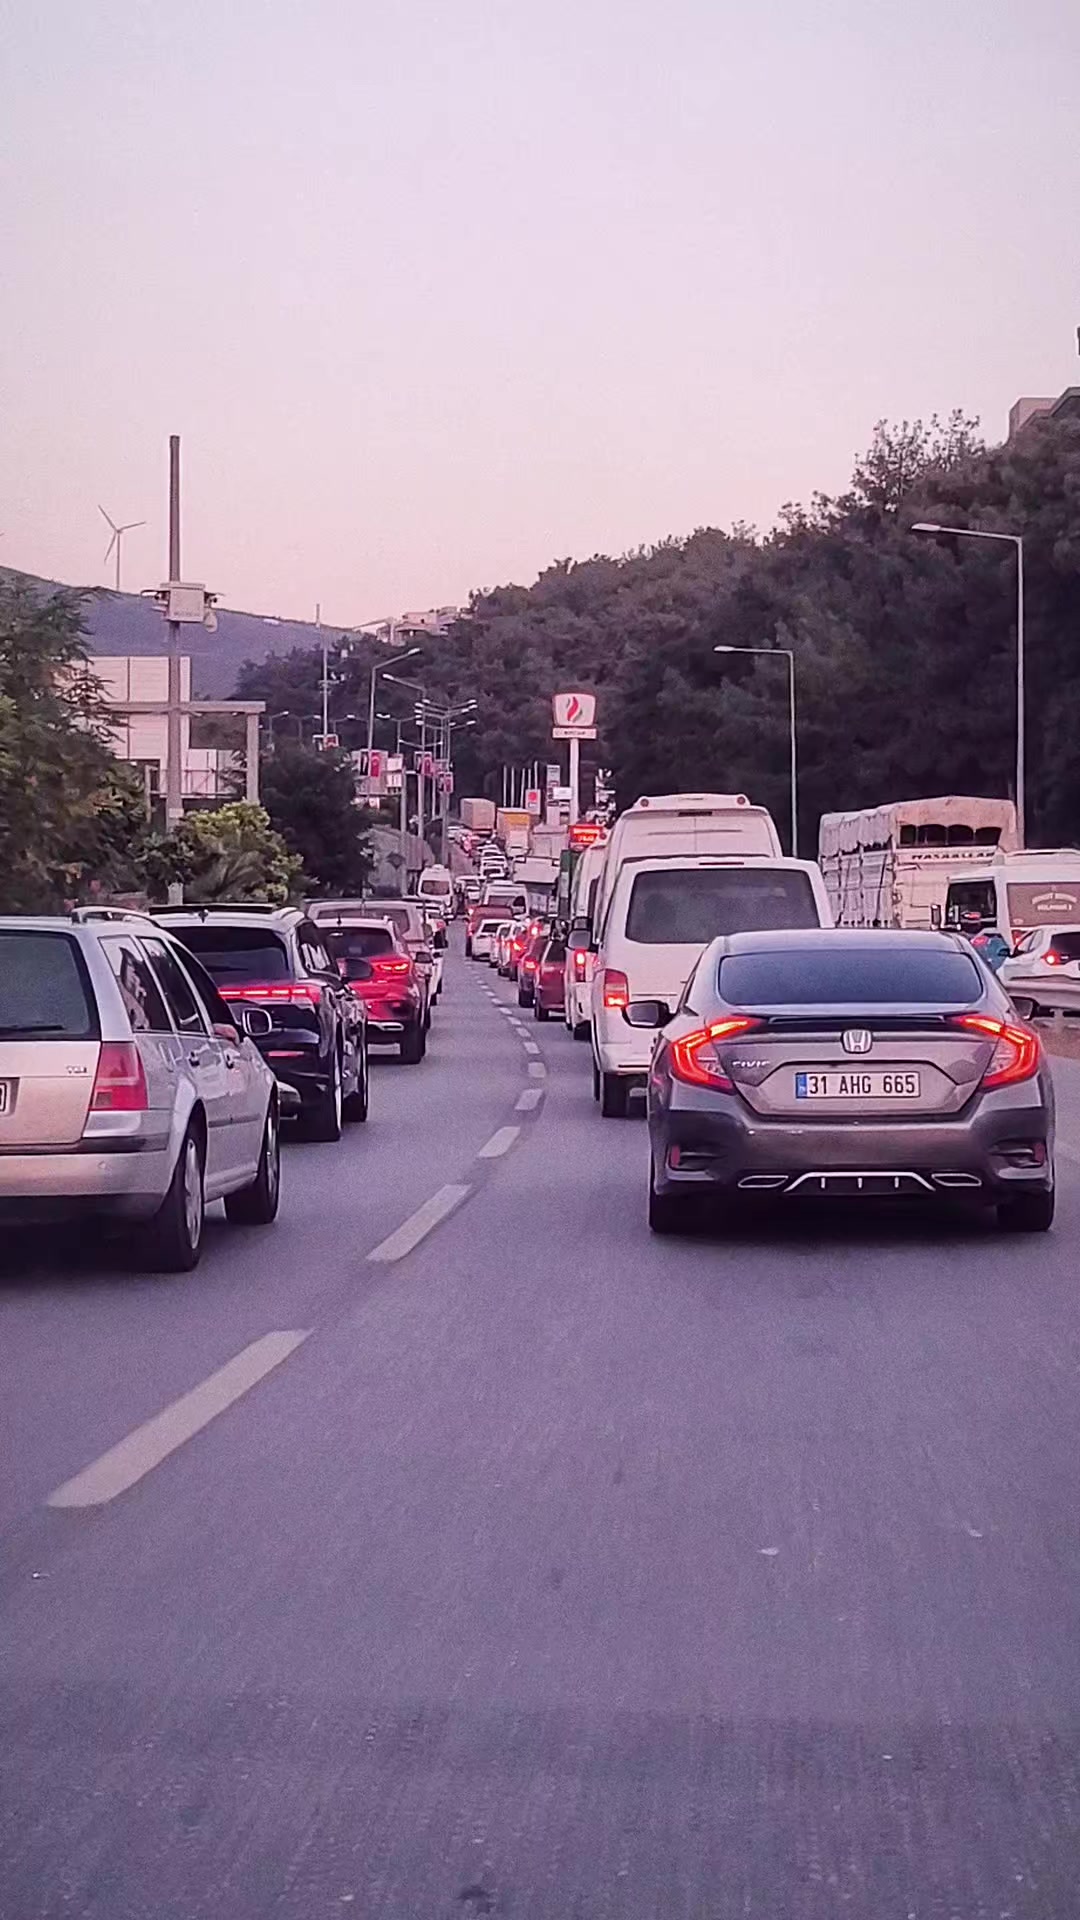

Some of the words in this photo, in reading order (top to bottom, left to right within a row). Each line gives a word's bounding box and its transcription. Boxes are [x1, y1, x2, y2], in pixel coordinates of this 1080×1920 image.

[808, 1075, 828, 1095] 31
[839, 1075, 872, 1095] AHG
[883, 1074, 915, 1094] 665
